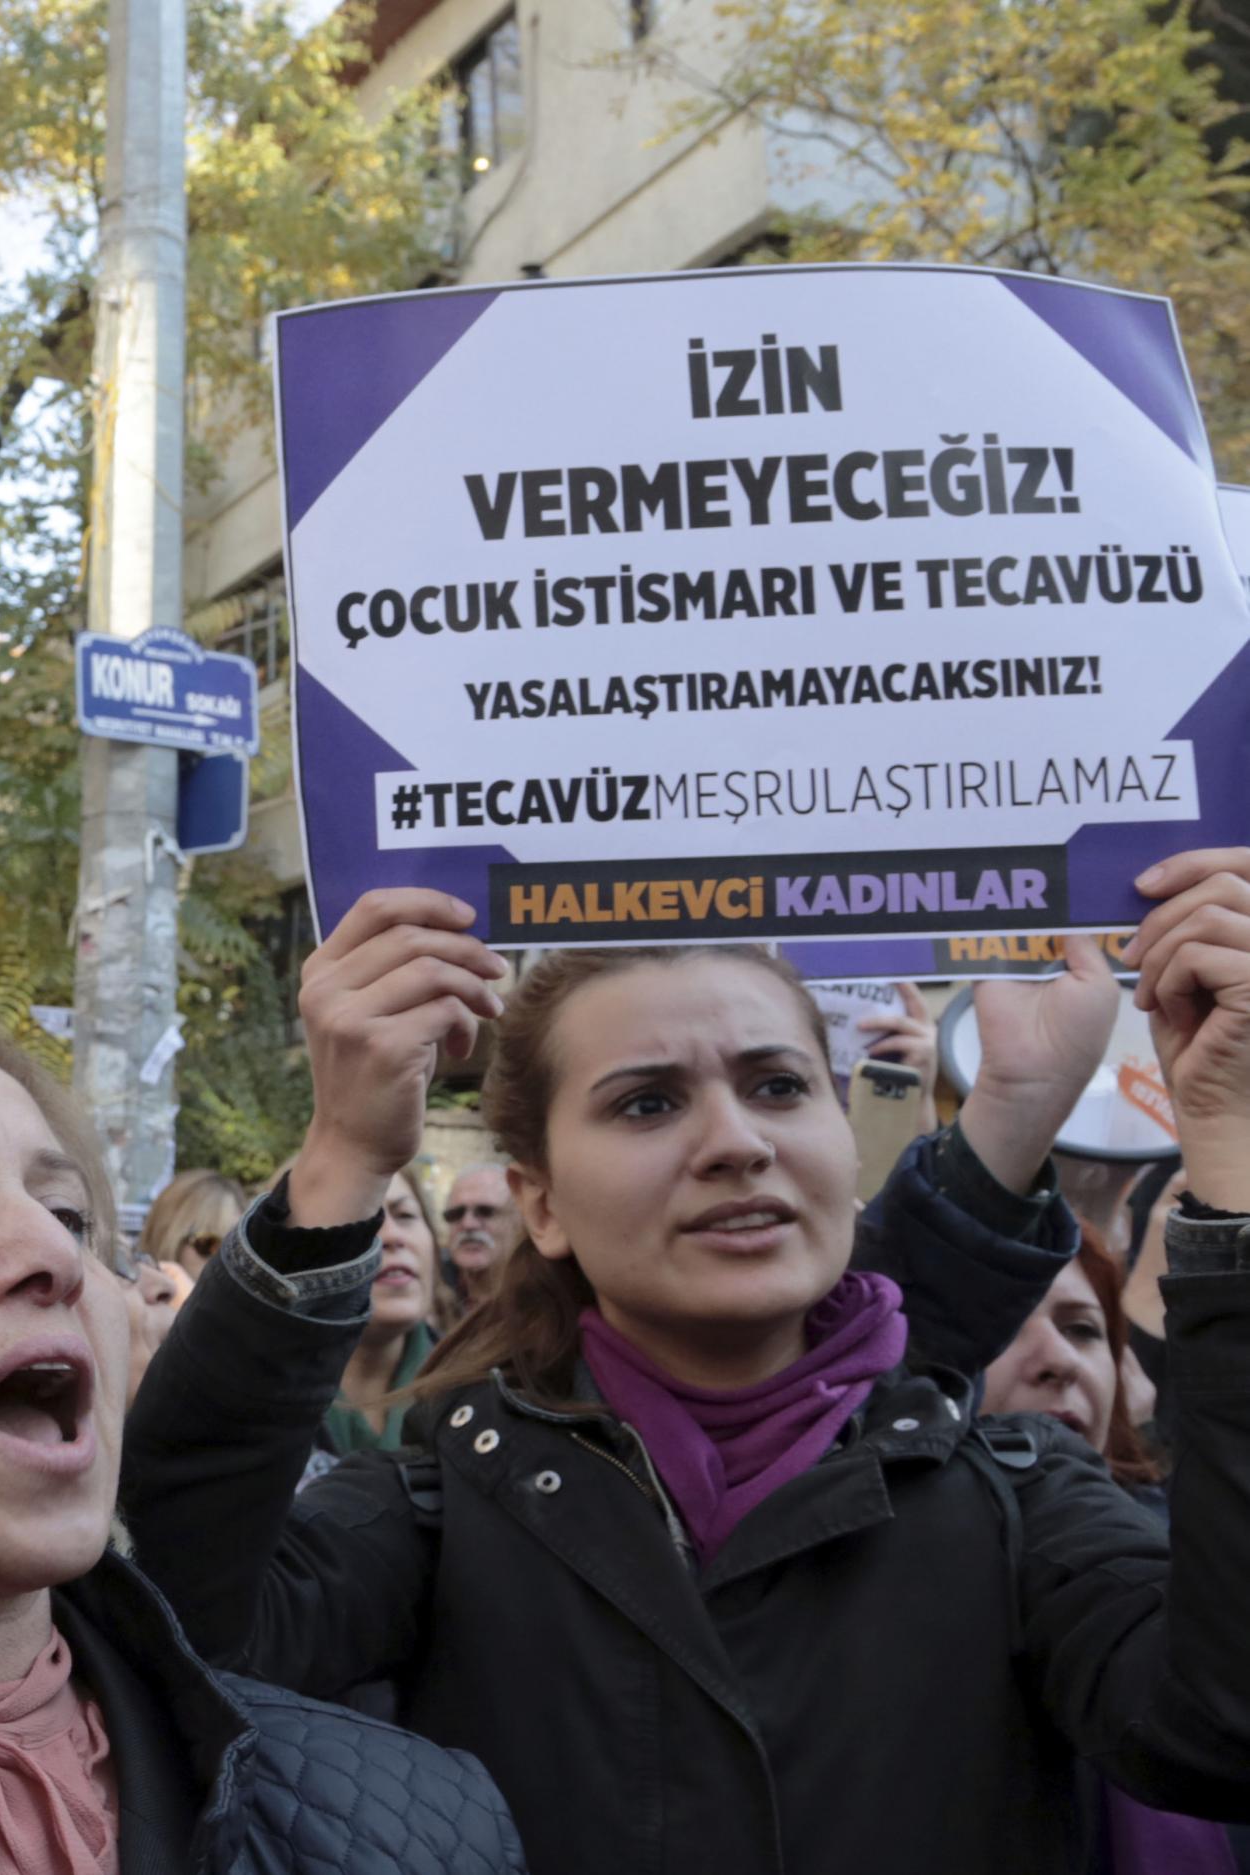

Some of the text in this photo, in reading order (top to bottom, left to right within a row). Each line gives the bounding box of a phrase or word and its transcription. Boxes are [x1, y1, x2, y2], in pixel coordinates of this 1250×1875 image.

[687, 333, 843, 418] İZİN
[463, 433, 1080, 541] VERMEYECEĞİZ!
[336, 544, 1204, 649] ÇOCUK İSTİSMARI VE TECAVÜZÜ
[91, 652, 175, 708] KONUR
[464, 655, 1102, 721] YASALAŞTIRAMAYACAKSINIZ!
[775, 868, 1048, 917] KADINLAR
